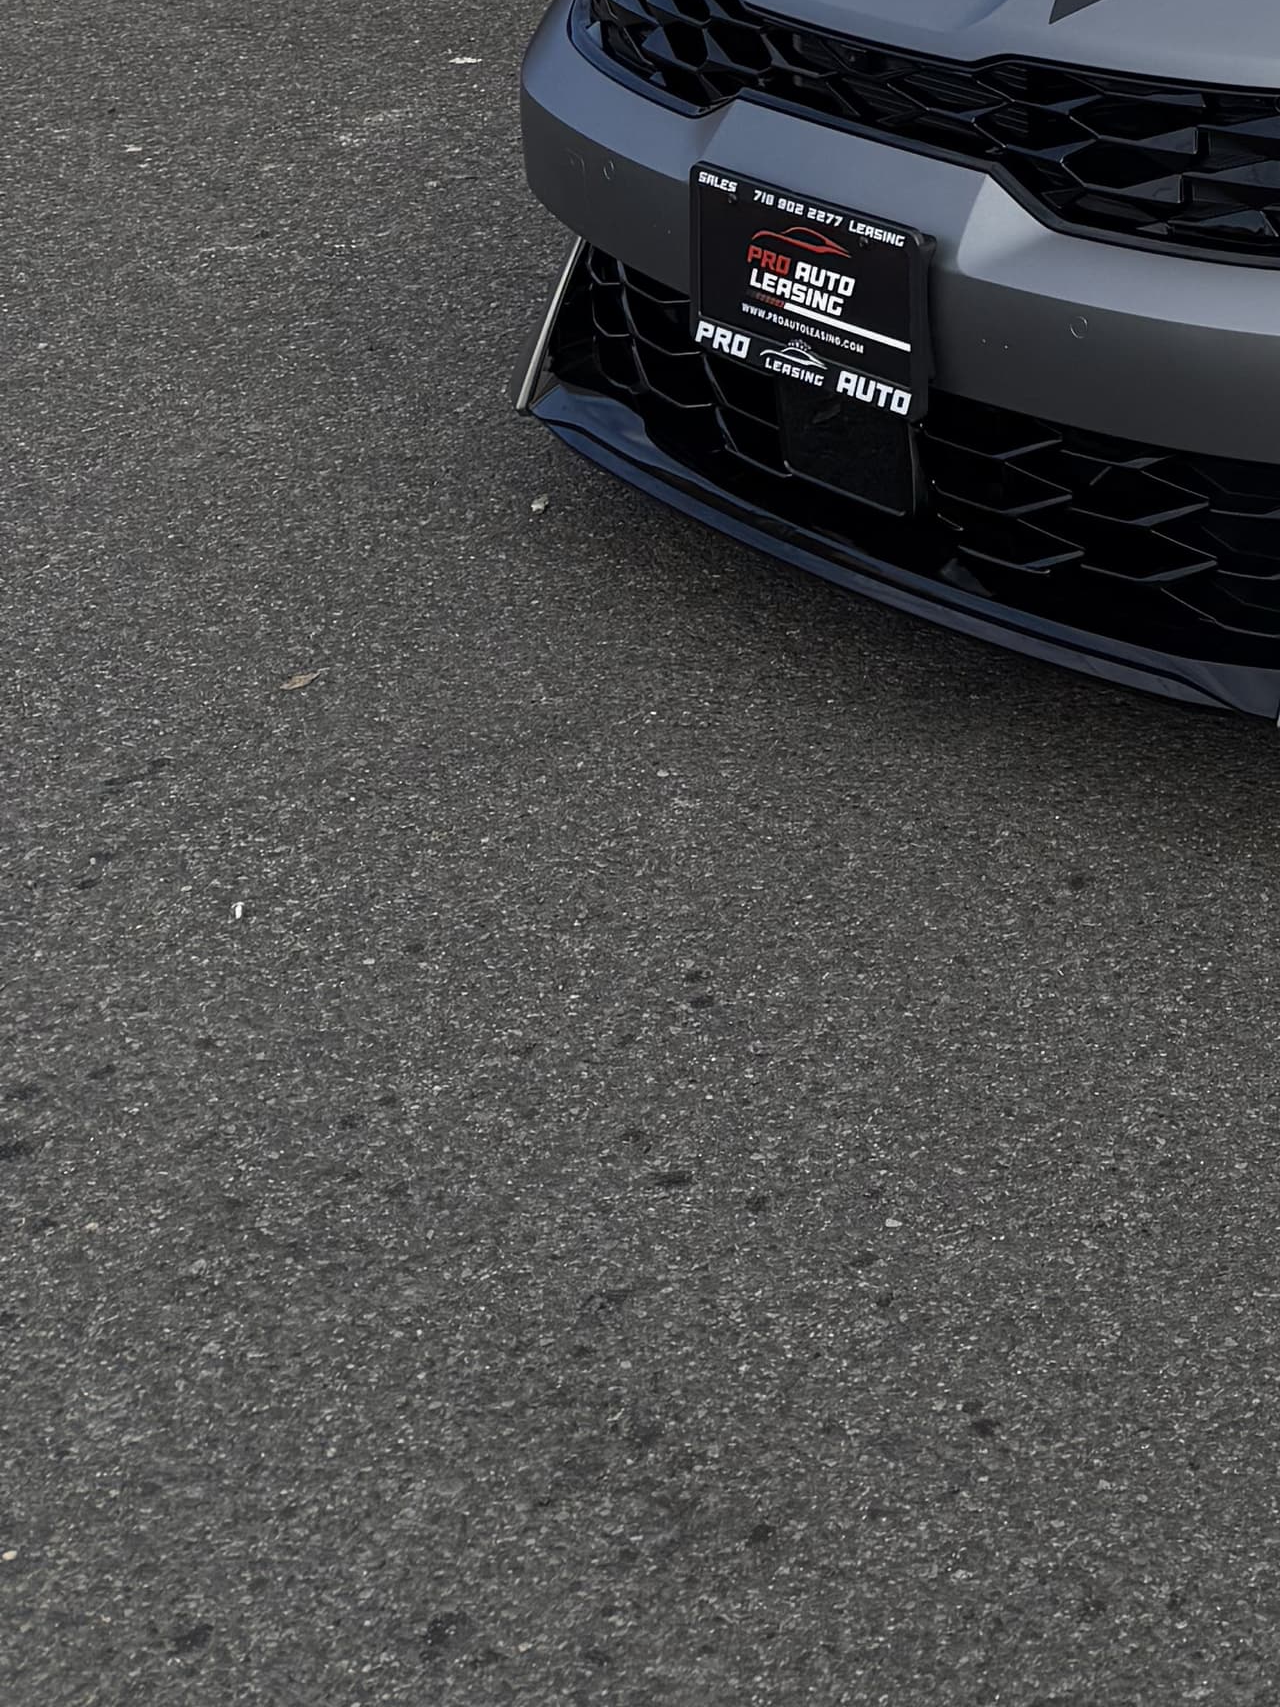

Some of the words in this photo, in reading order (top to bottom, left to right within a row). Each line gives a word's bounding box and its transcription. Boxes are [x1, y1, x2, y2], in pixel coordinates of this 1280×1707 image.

[698, 171, 738, 193] SALES
[753, 189, 775, 206] 718
[777, 198, 804, 216] 902
[807, 207, 843, 228] 2277
[848, 219, 905, 247] LEASING
[747, 244, 791, 276] PRO
[794, 261, 855, 297] AUTO
[750, 268, 845, 316] LEASING
[695, 320, 751, 359] PRO
[764, 357, 825, 387] LEASING
[836, 370, 912, 416] AUTO
